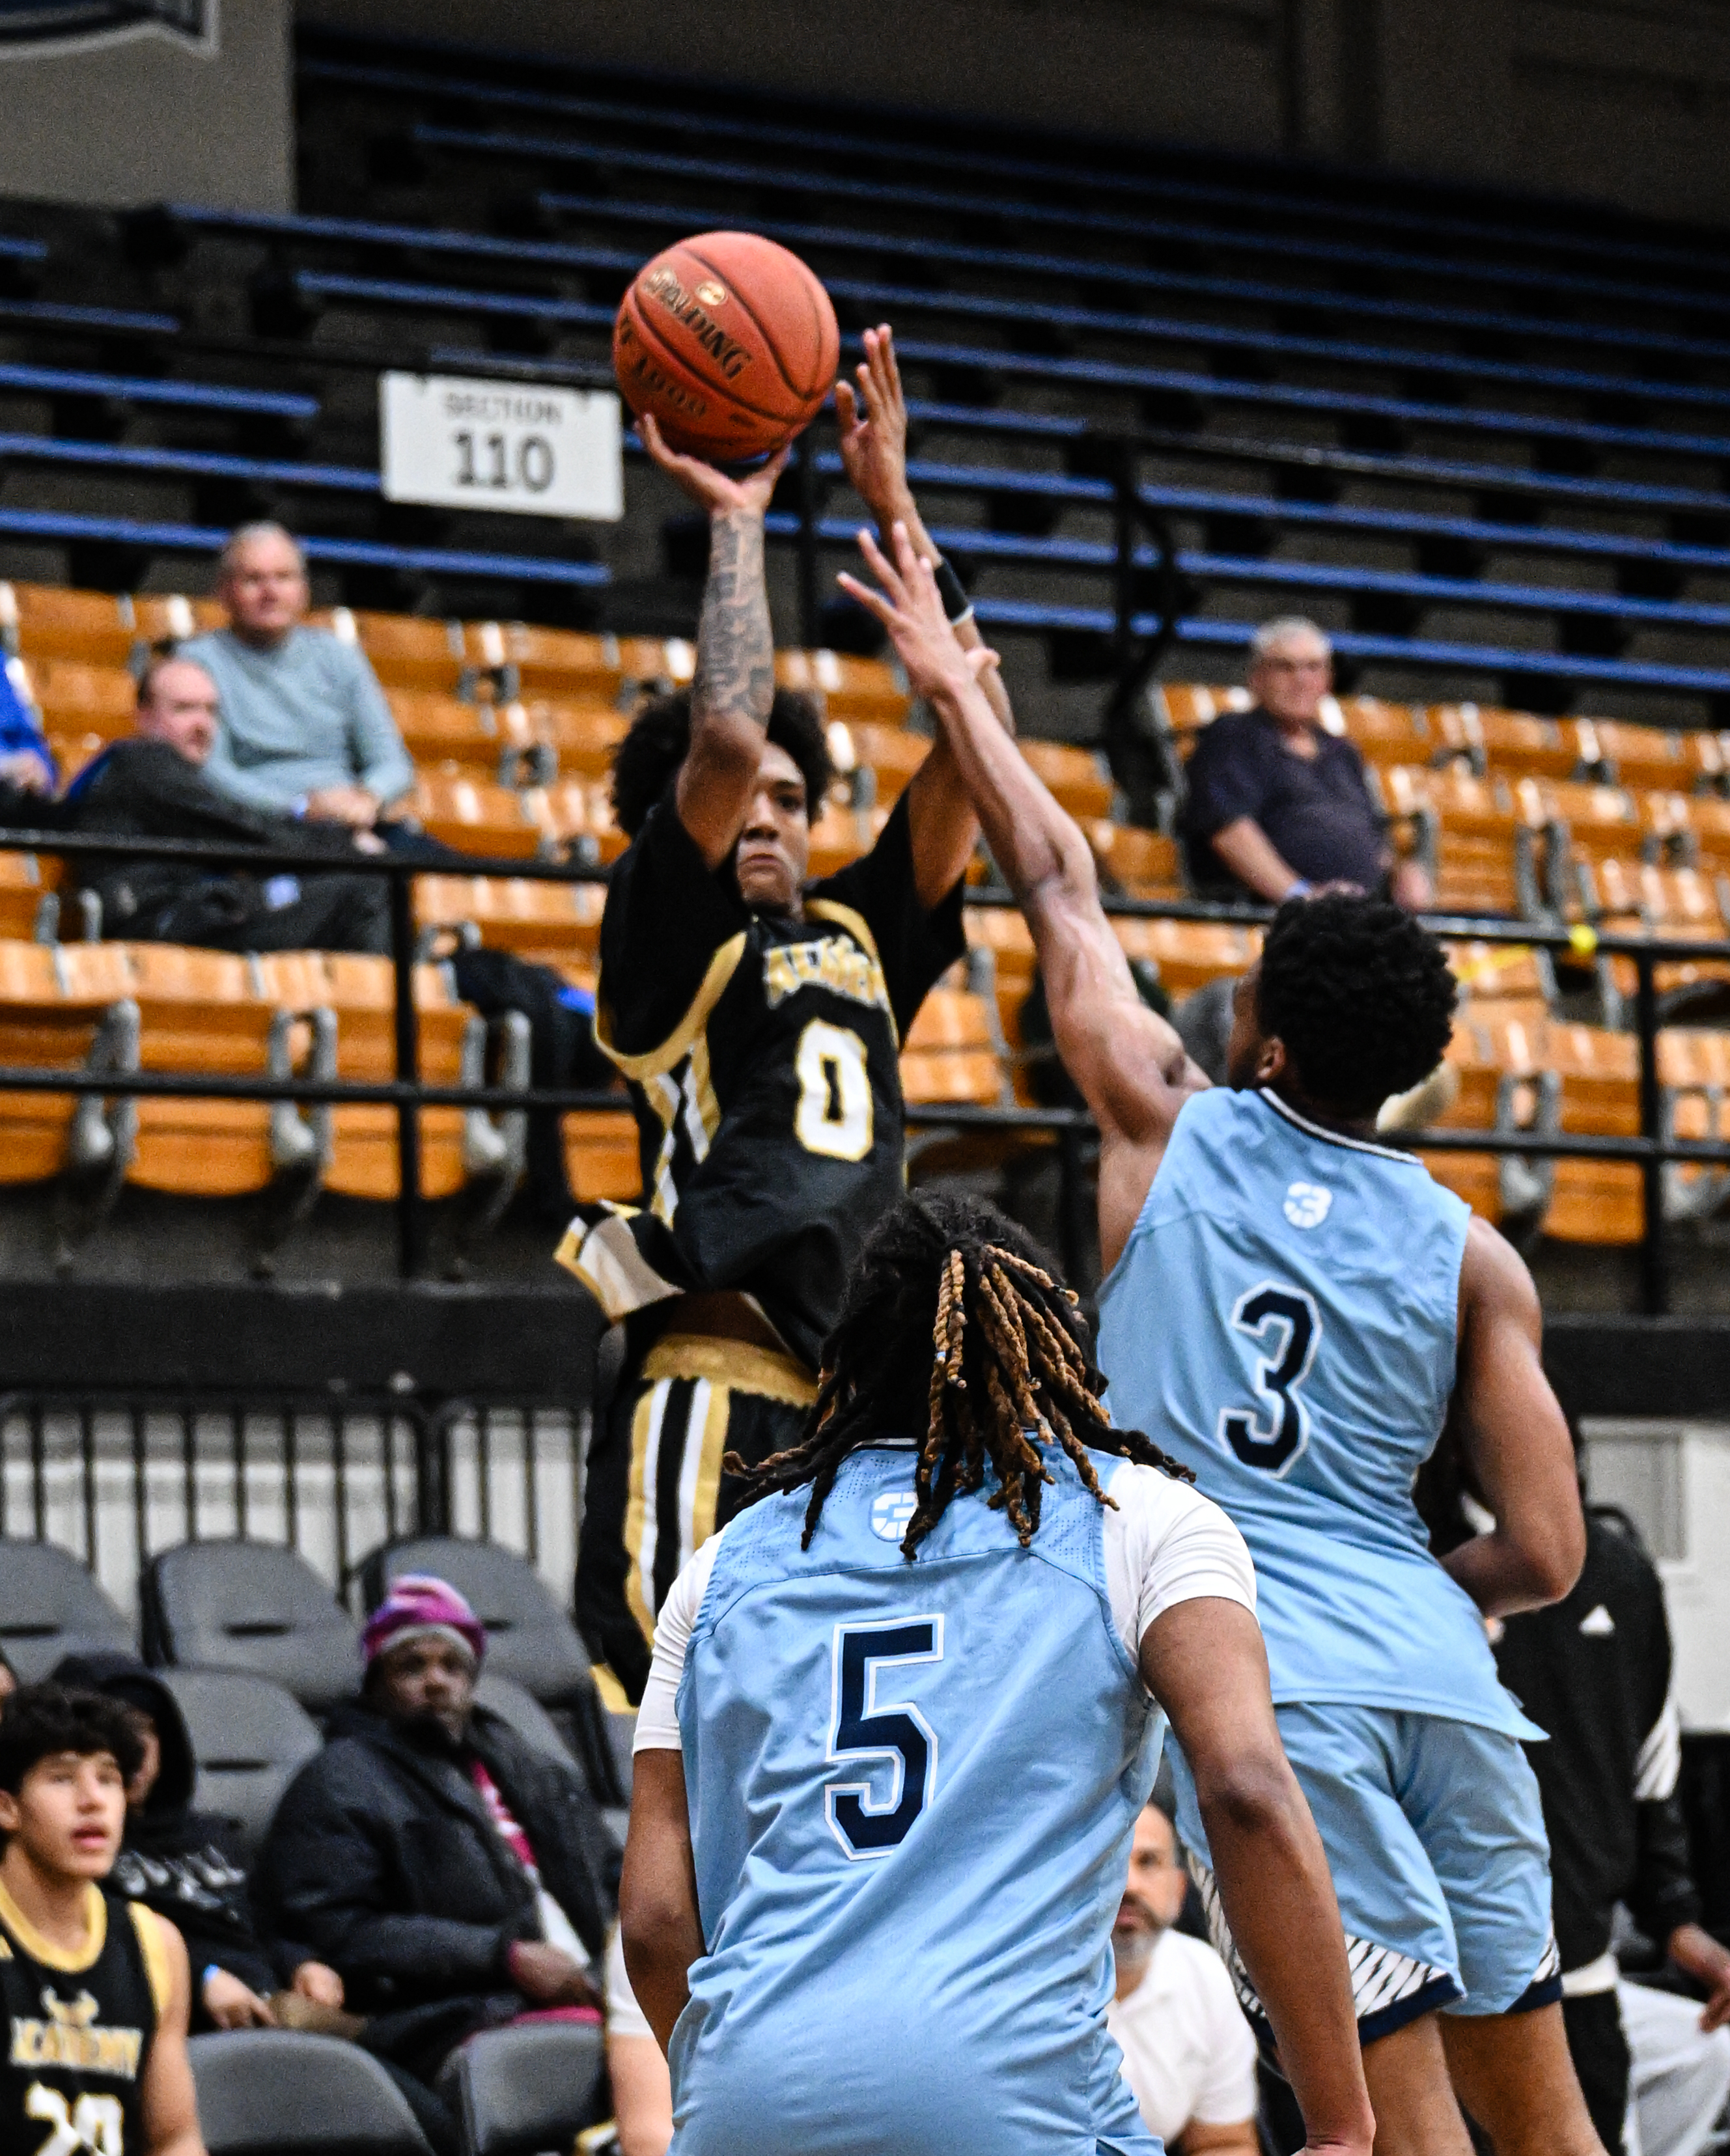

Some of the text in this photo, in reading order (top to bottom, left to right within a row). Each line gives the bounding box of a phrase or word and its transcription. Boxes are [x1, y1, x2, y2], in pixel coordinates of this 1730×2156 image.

[641, 268, 752, 380] SPALDING
[443, 391, 563, 425] SECTION
[454, 428, 554, 493] 110
[794, 1017, 874, 1163] 0
[1218, 1281, 1322, 1479] 3
[824, 1612, 945, 1862] 5
